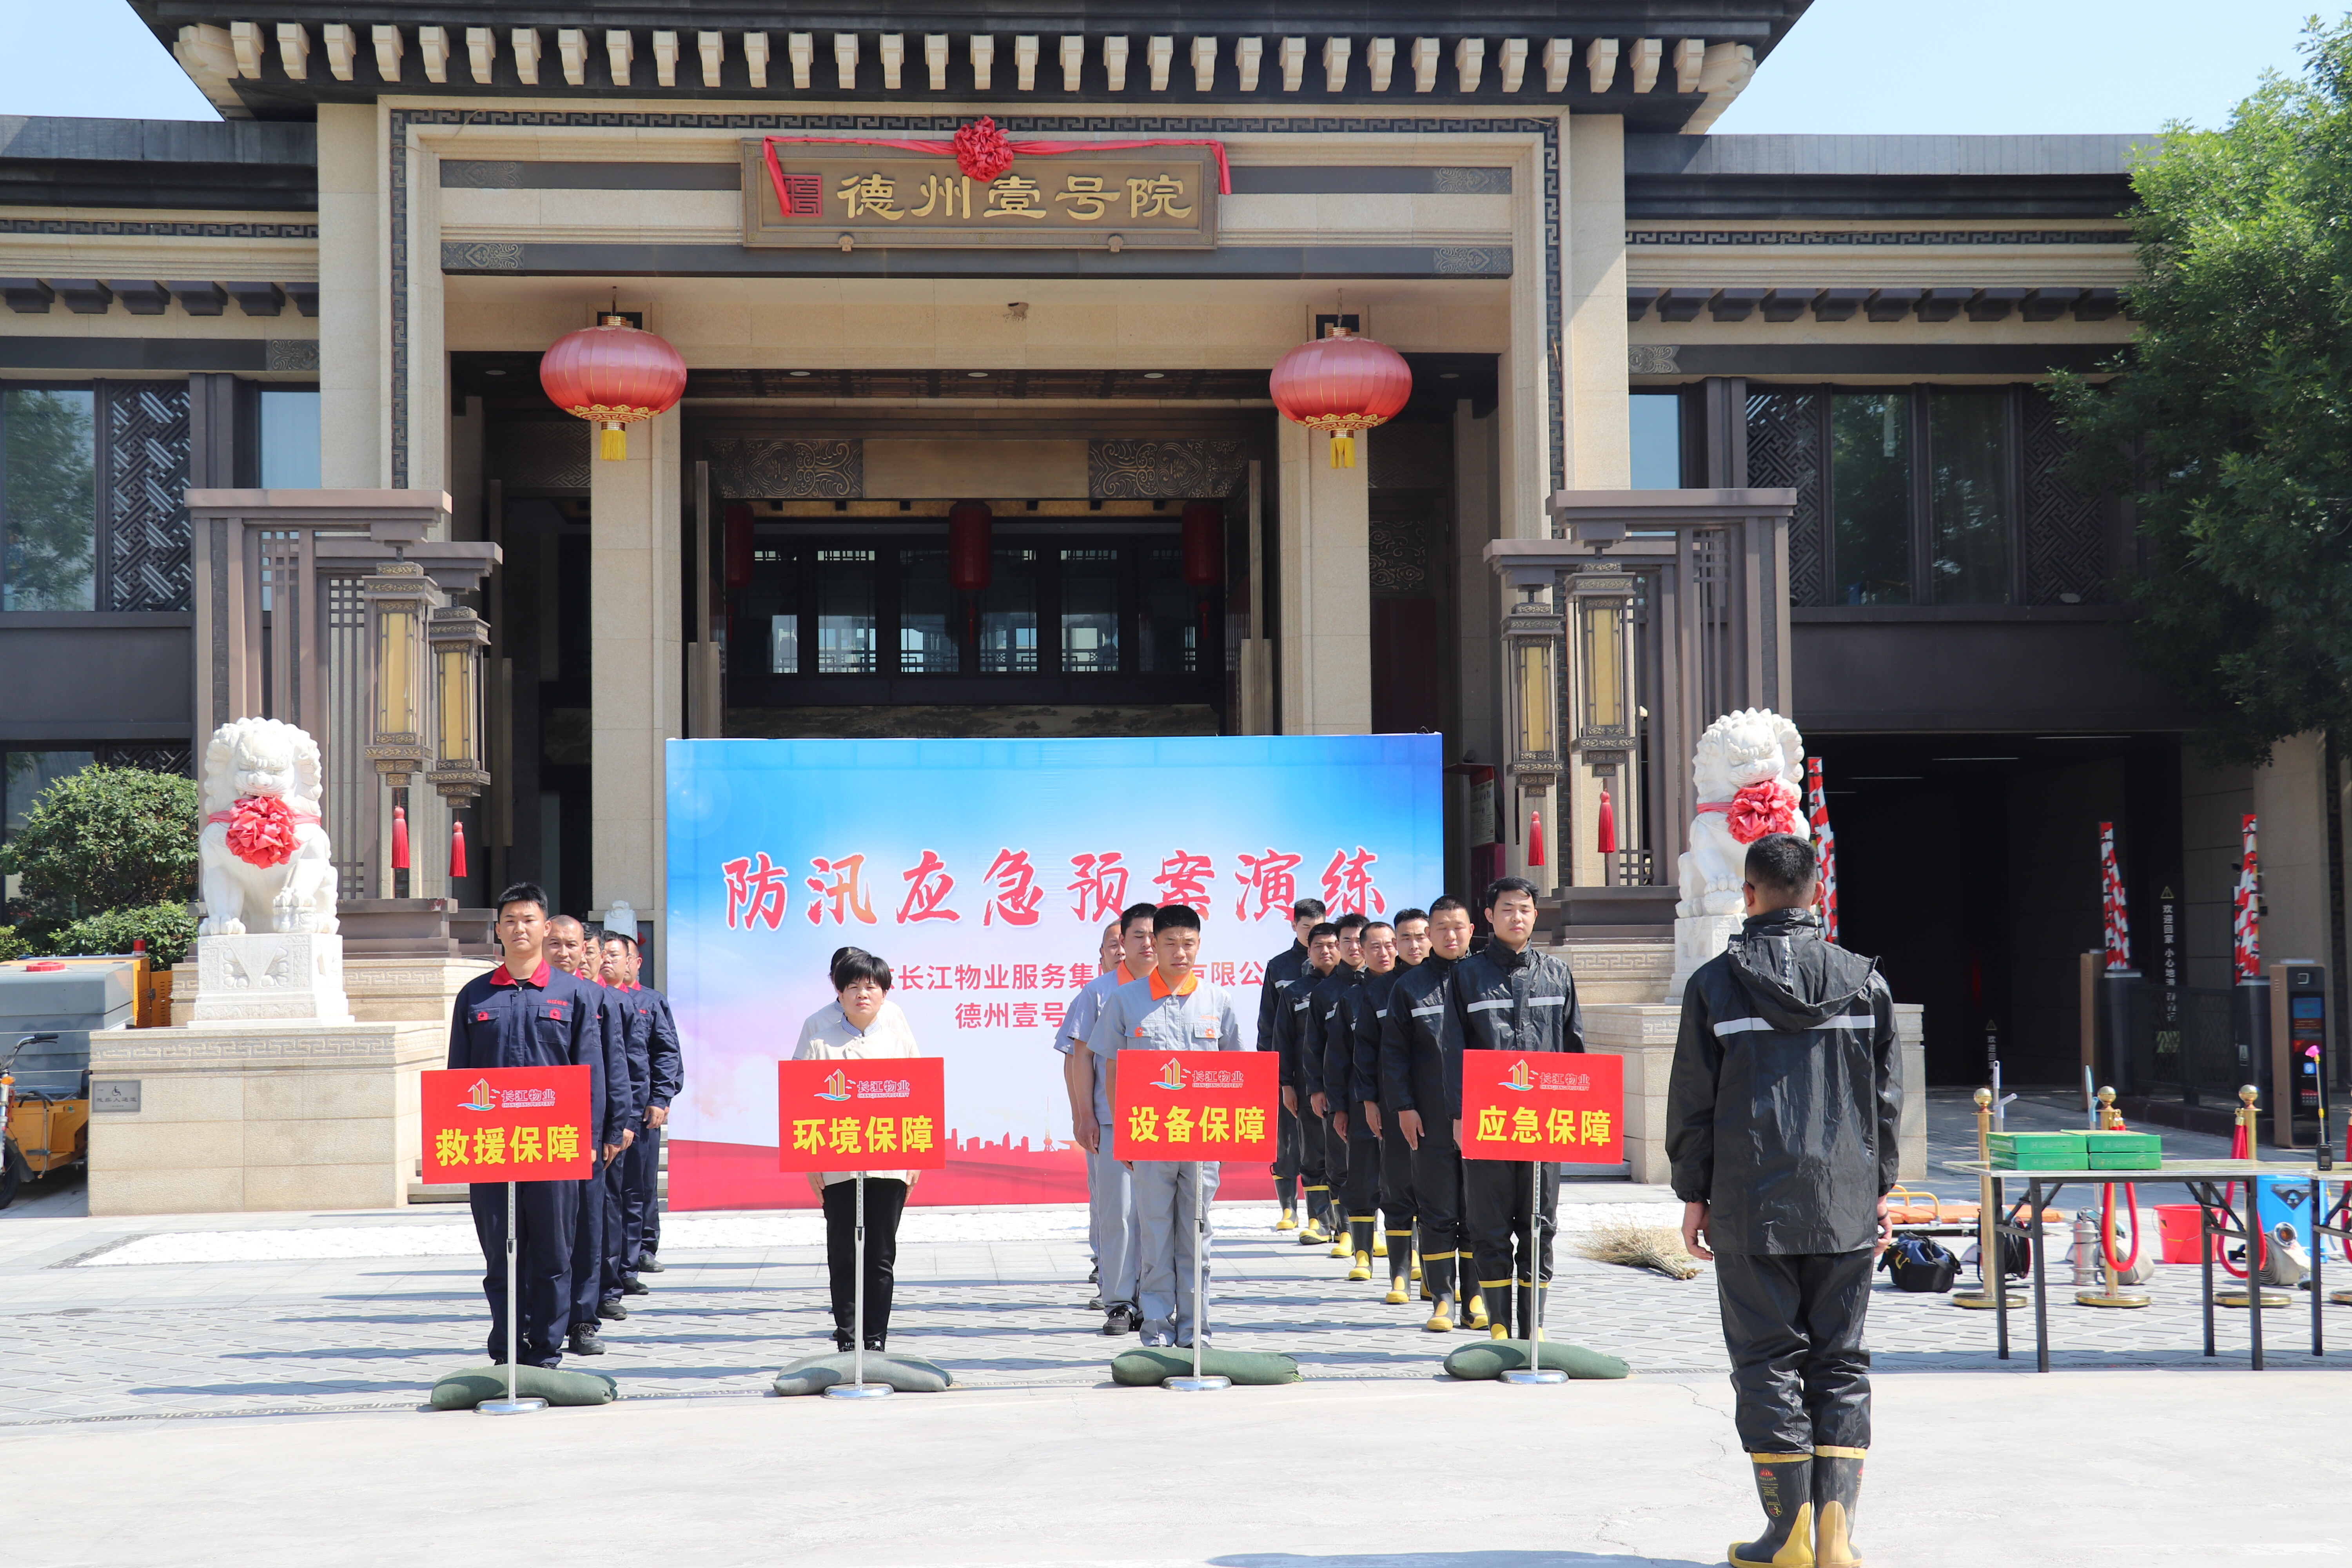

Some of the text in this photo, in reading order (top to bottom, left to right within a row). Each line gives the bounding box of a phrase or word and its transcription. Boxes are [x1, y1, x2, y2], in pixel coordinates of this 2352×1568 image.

[837, 173, 1192, 220] 德州壹号院
[723, 848, 1385, 929] 防汛应急预案演练
[889, 963, 1103, 990] 长江物业服务集
[955, 1002, 1072, 1029] 德州壹号
[857, 1080, 910, 1093] 长江物业
[1192, 1070, 1244, 1082] 长江物业
[1539, 1072, 1590, 1086] 长江物业
[501, 1089, 555, 1102] 长江物业
[793, 1115, 934, 1155] 环境保障
[1128, 1105, 1265, 1143] 设备保障
[1475, 1105, 1611, 1147] 应急保障
[435, 1124, 580, 1167] 救援保障
